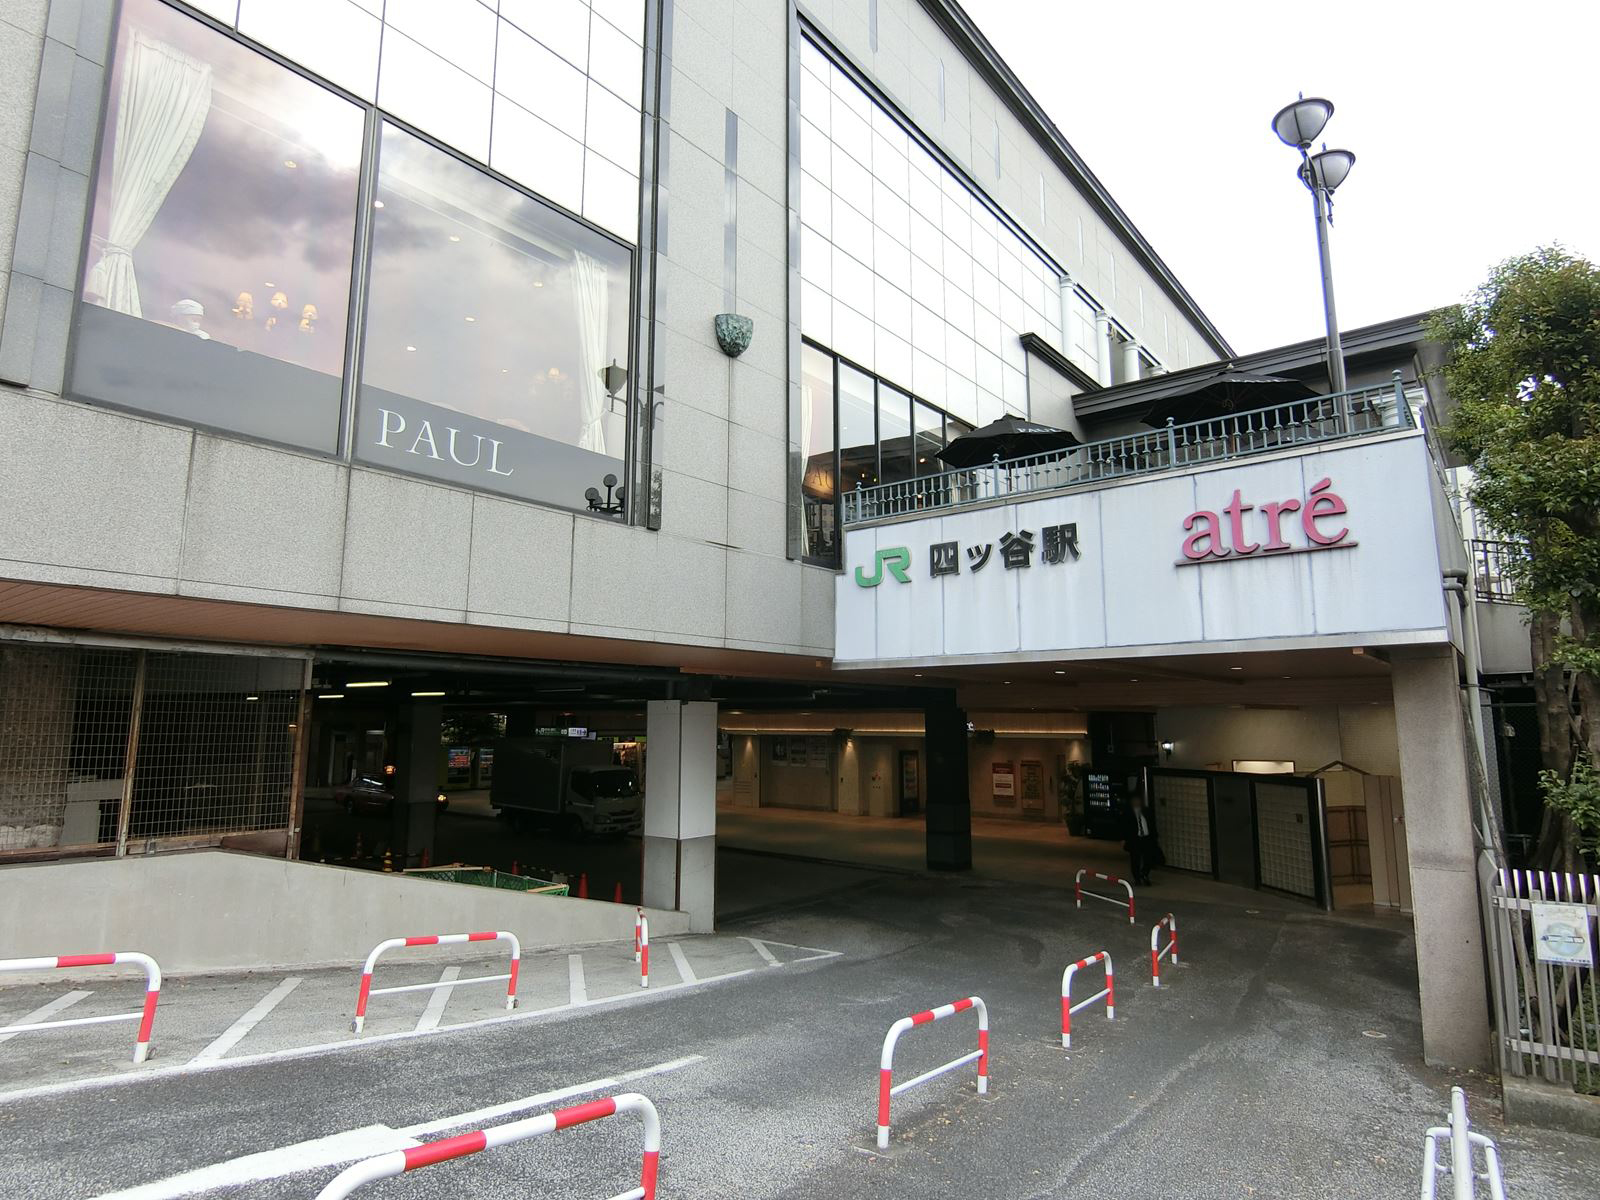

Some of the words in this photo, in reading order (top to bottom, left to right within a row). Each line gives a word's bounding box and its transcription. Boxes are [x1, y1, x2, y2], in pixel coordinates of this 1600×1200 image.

[375, 408, 514, 476] PAUL
[1182, 477, 1349, 559] atré
[855, 547, 912, 588] JR
[930, 522, 1081, 578] 四ツ谷駅
